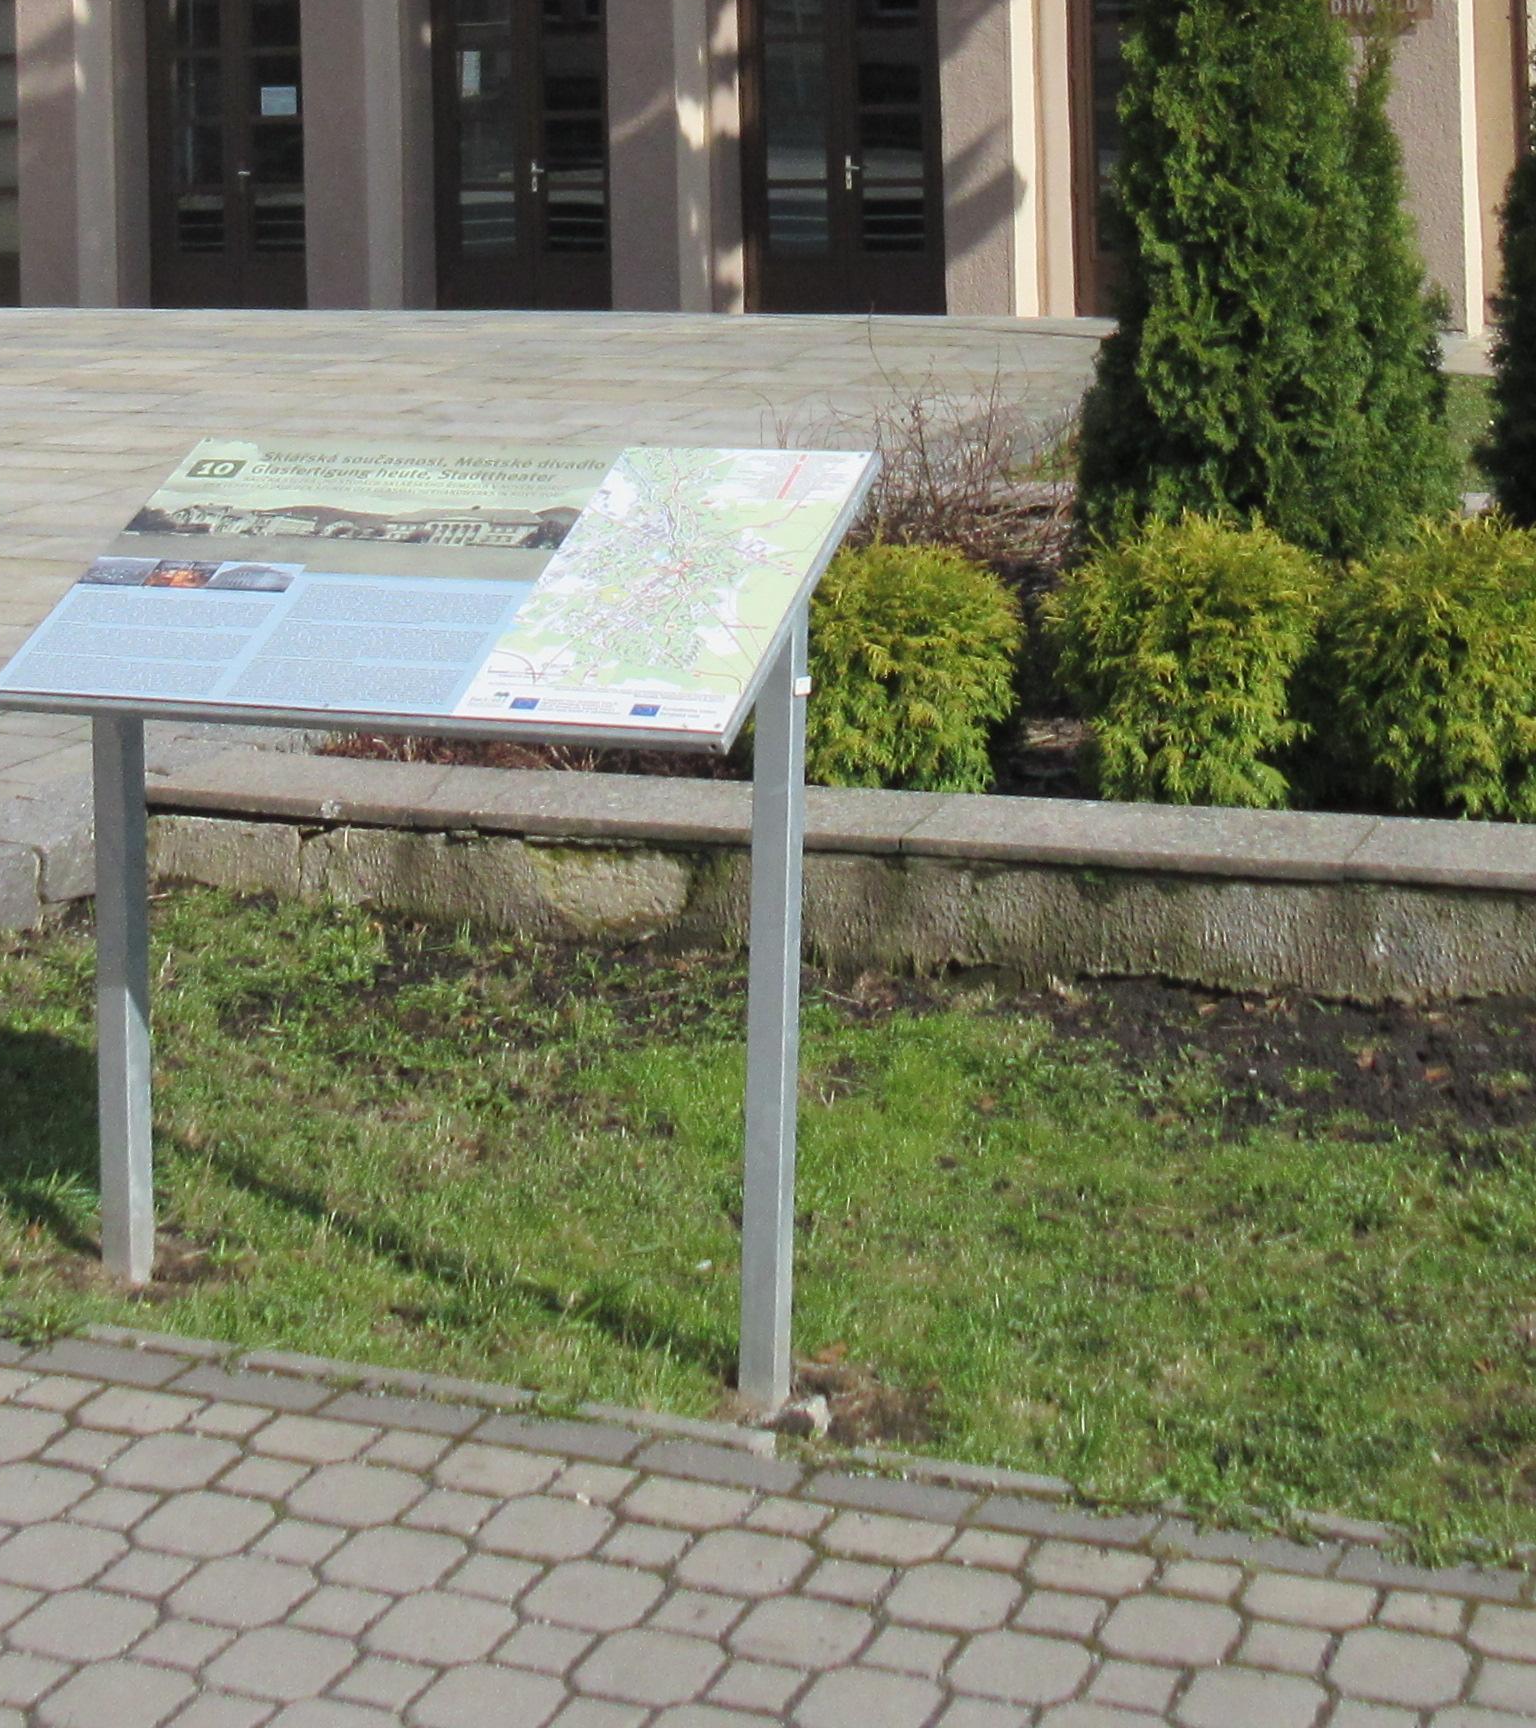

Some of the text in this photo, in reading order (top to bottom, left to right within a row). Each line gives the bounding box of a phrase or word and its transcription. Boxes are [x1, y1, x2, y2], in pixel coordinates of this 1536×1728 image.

[194, 461, 236, 476] 10
[455, 456, 533, 468] Městské
[536, 459, 606, 471] divadlo
[250, 463, 556, 482] Glasfertigung heute, Stadttheater
